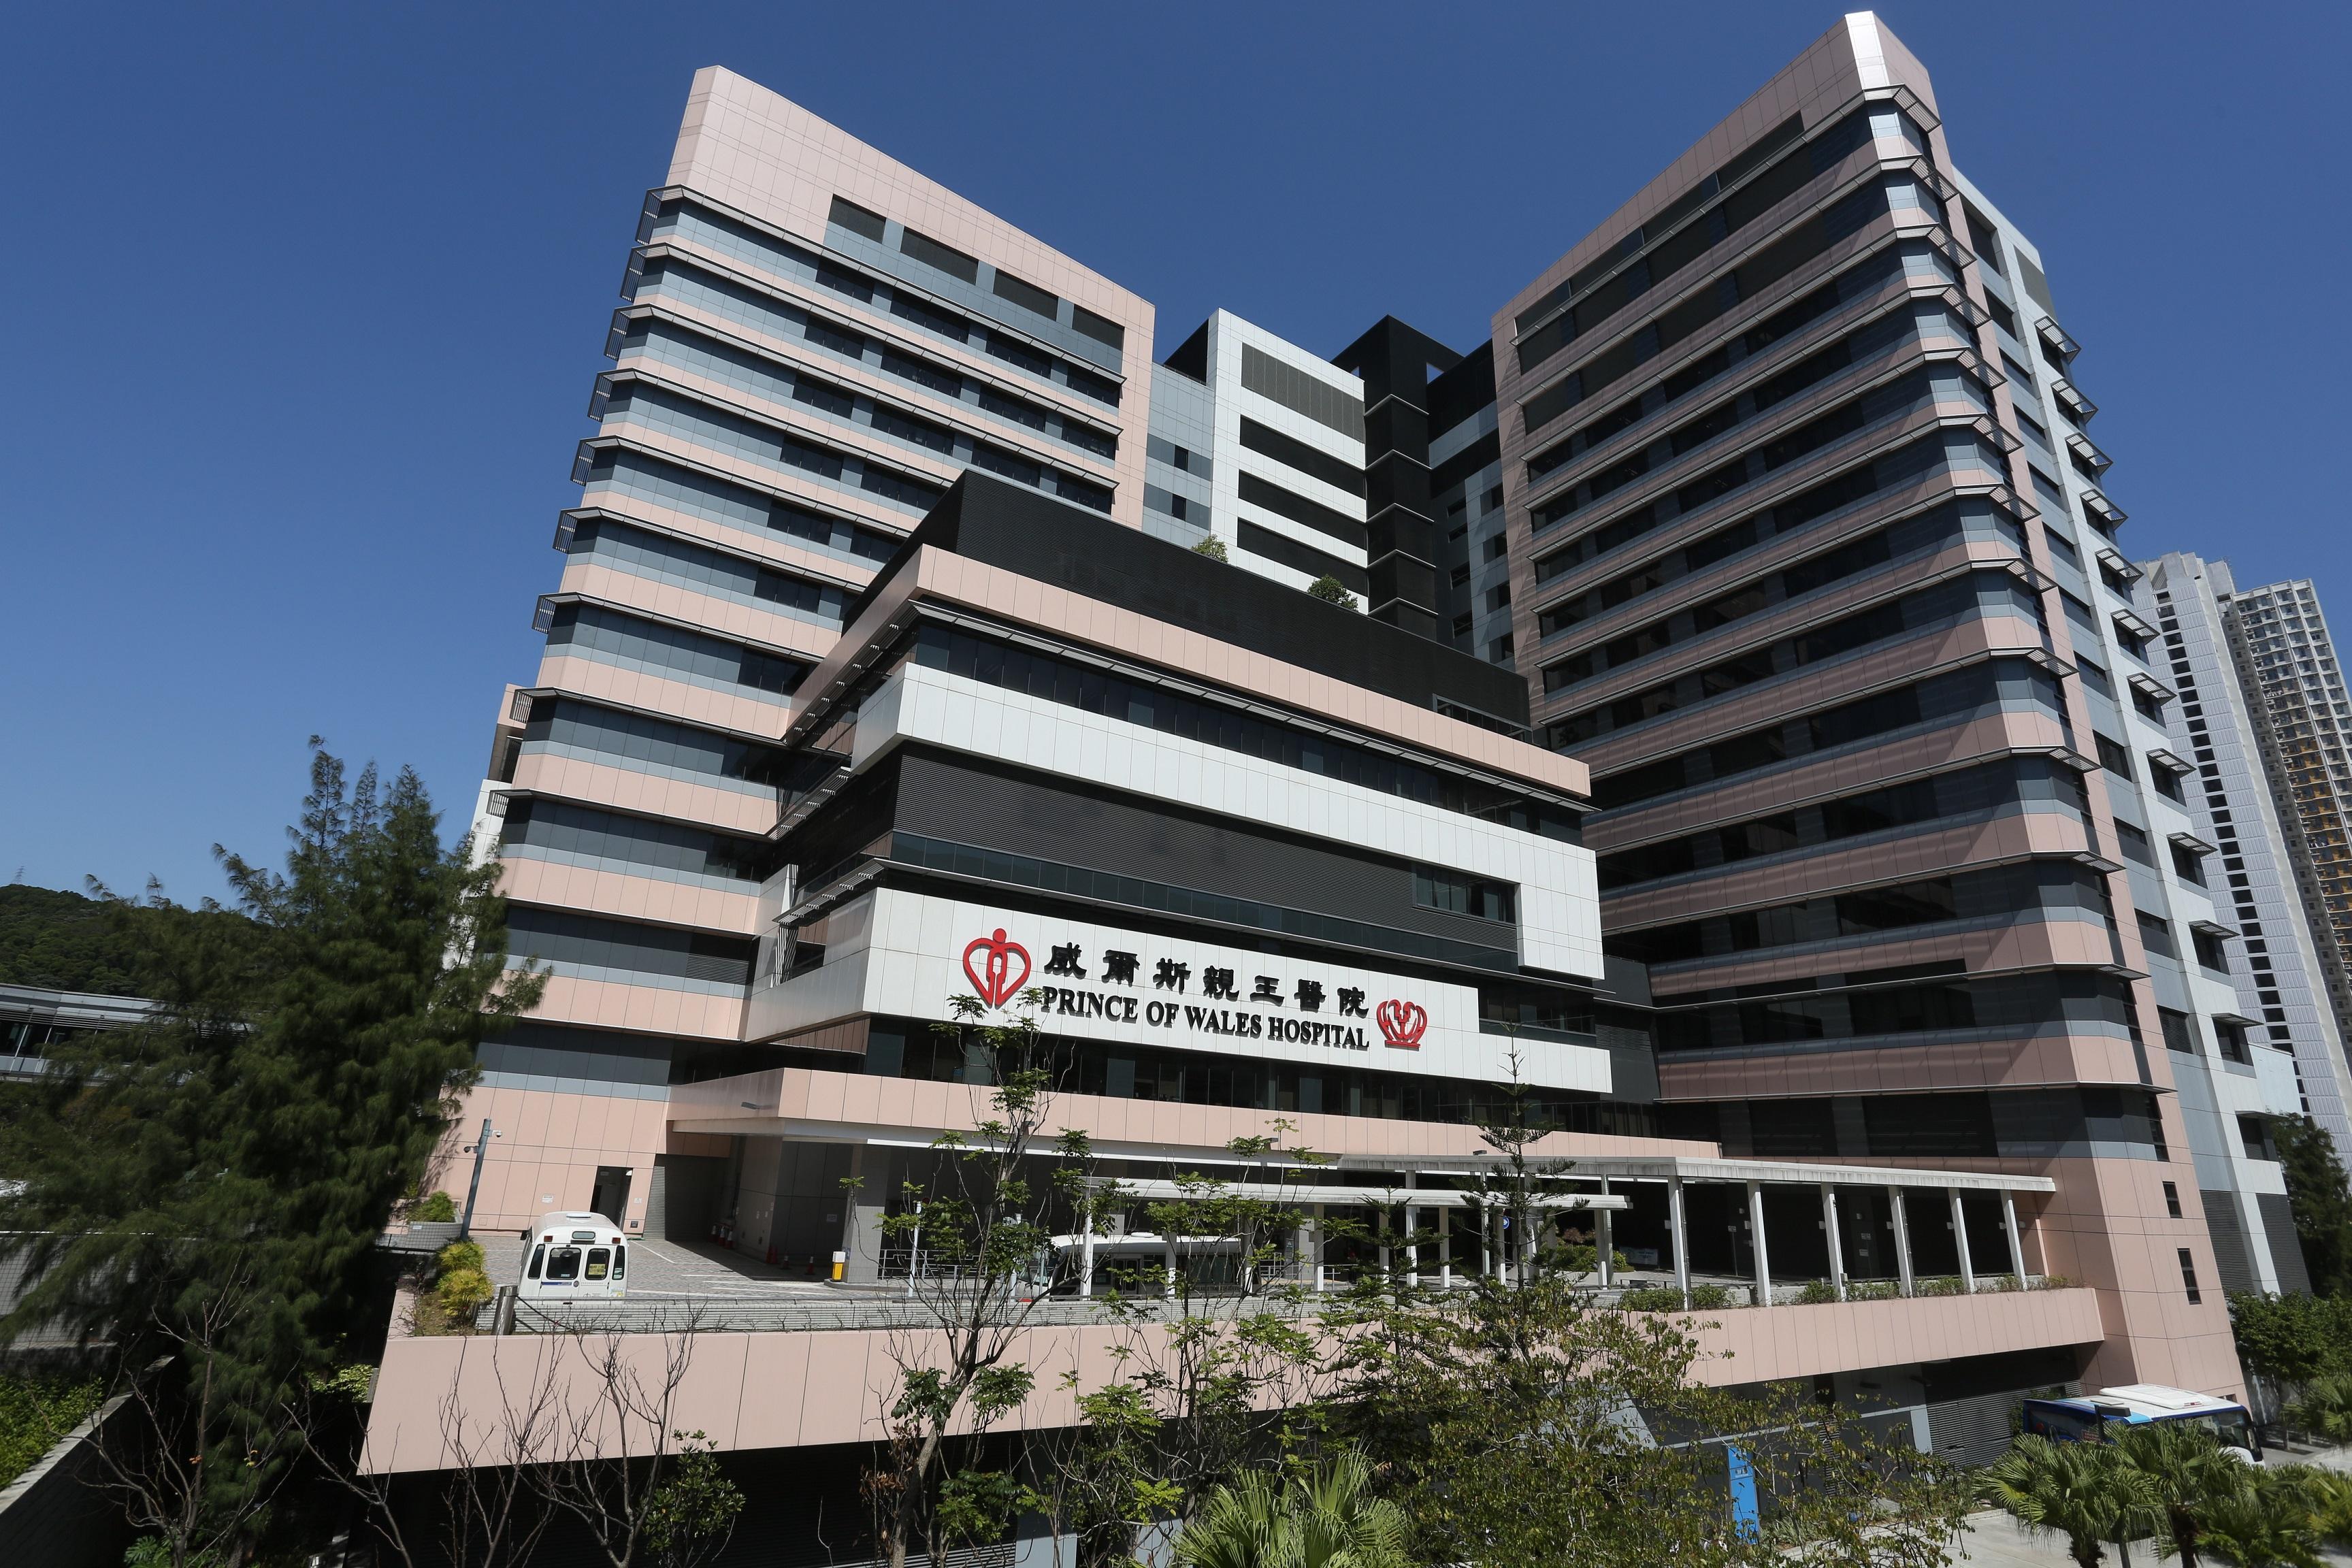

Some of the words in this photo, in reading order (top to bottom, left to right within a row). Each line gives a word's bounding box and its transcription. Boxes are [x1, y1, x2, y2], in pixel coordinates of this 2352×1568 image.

[1043, 942, 1370, 1019] 威爾斯親王醫院
[1041, 985, 1139, 1024] PRINCE
[1145, 1000, 1179, 1028] OF
[1183, 1005, 1262, 1039] WALES
[1267, 1016, 1370, 1051] HOSPITAL
